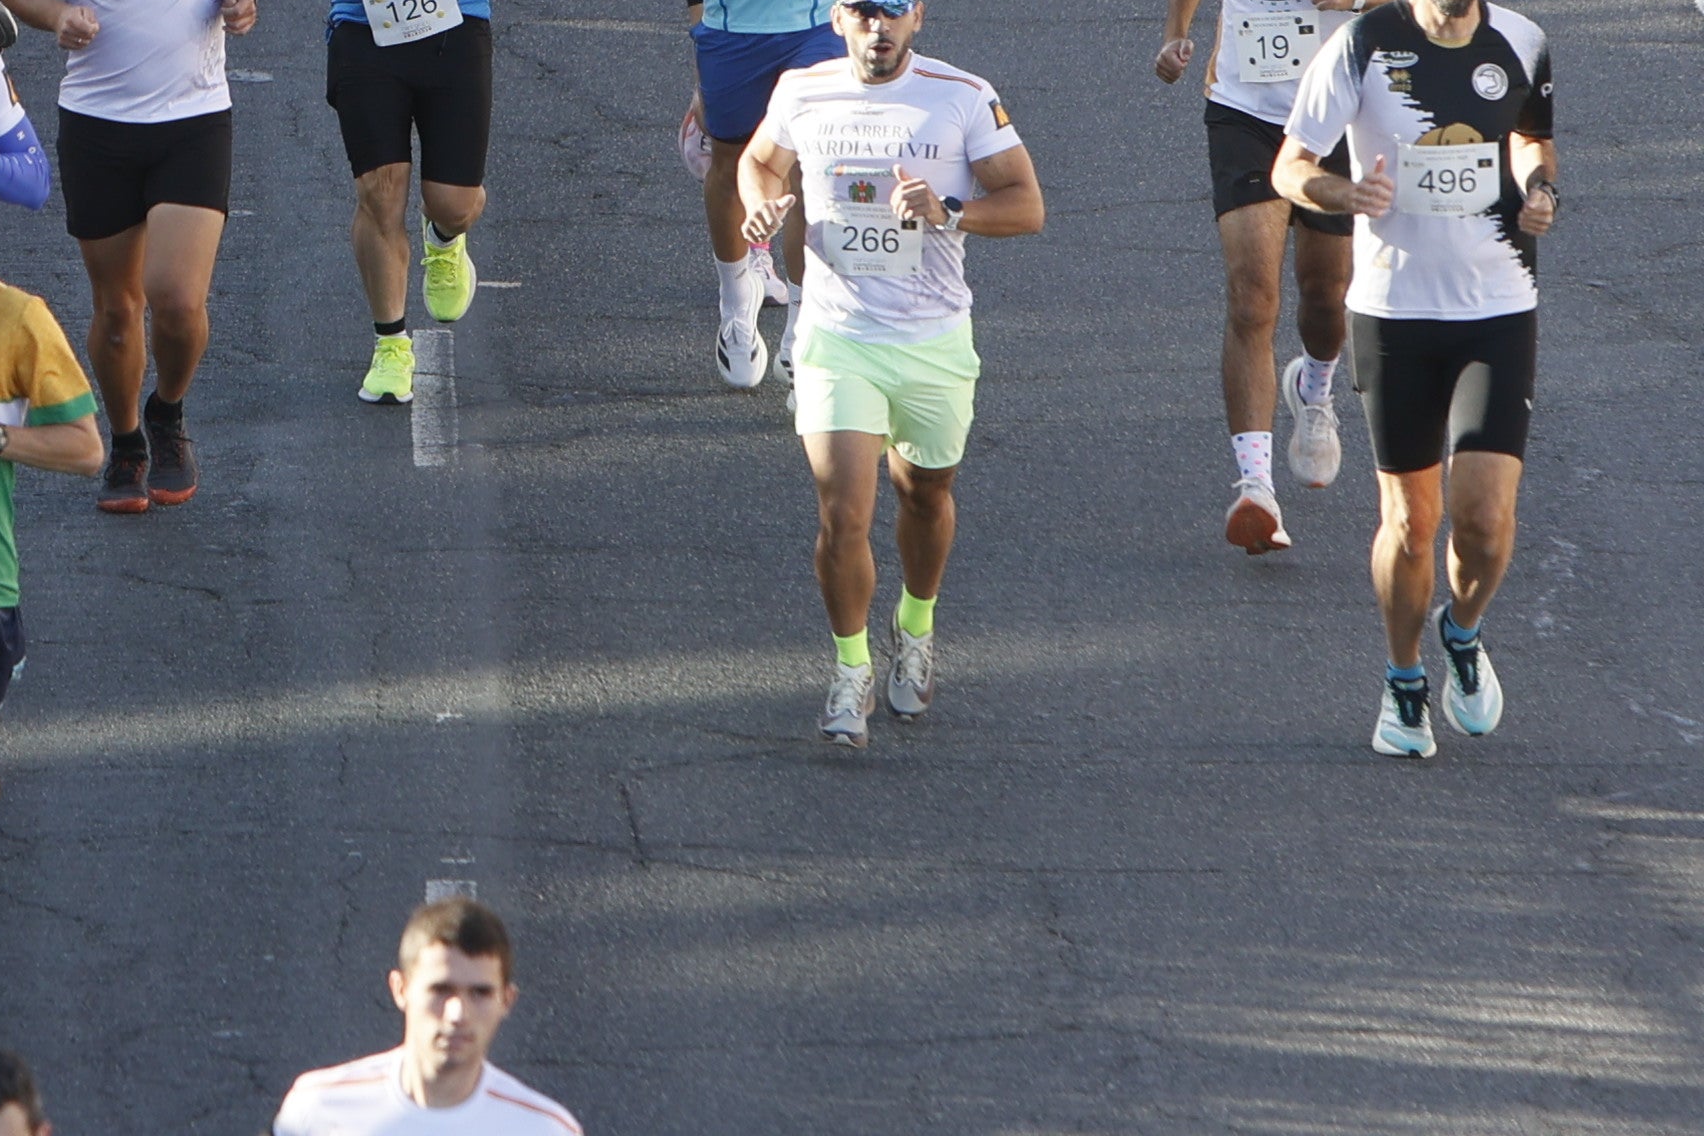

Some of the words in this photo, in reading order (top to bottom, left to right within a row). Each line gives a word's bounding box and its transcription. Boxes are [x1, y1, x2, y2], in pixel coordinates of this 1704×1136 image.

[1255, 33, 1290, 61] 19
[817, 123, 835, 137] III
[839, 123, 915, 139] CARRERA
[884, 141, 944, 162] CIVIL
[1416, 167, 1478, 194] 496
[841, 225, 901, 254] 266
